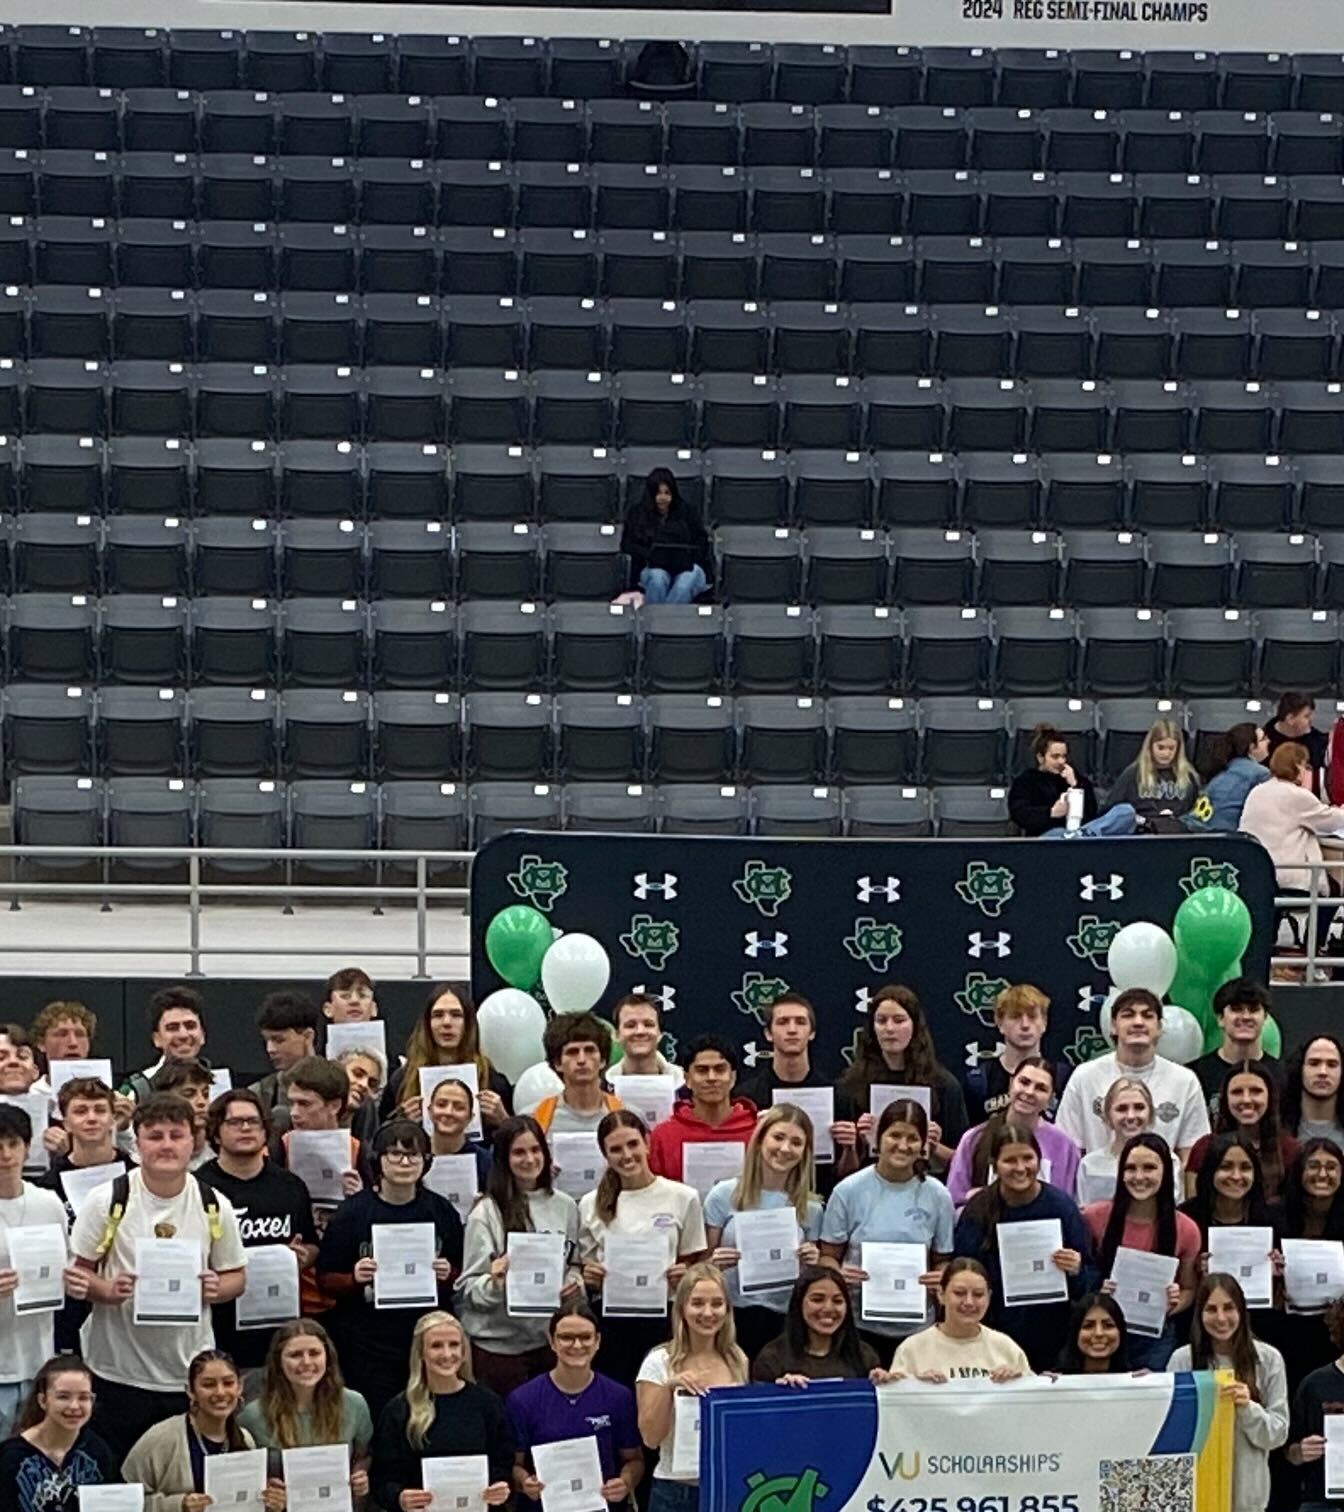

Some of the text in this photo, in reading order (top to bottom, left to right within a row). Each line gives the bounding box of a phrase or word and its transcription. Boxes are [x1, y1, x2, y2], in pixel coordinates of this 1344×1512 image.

[962, 1, 1208, 22] 2024 REG SEMI-FINAL CHAMPS
[927, 1453, 1060, 1475] SCHOLARSHIPS
